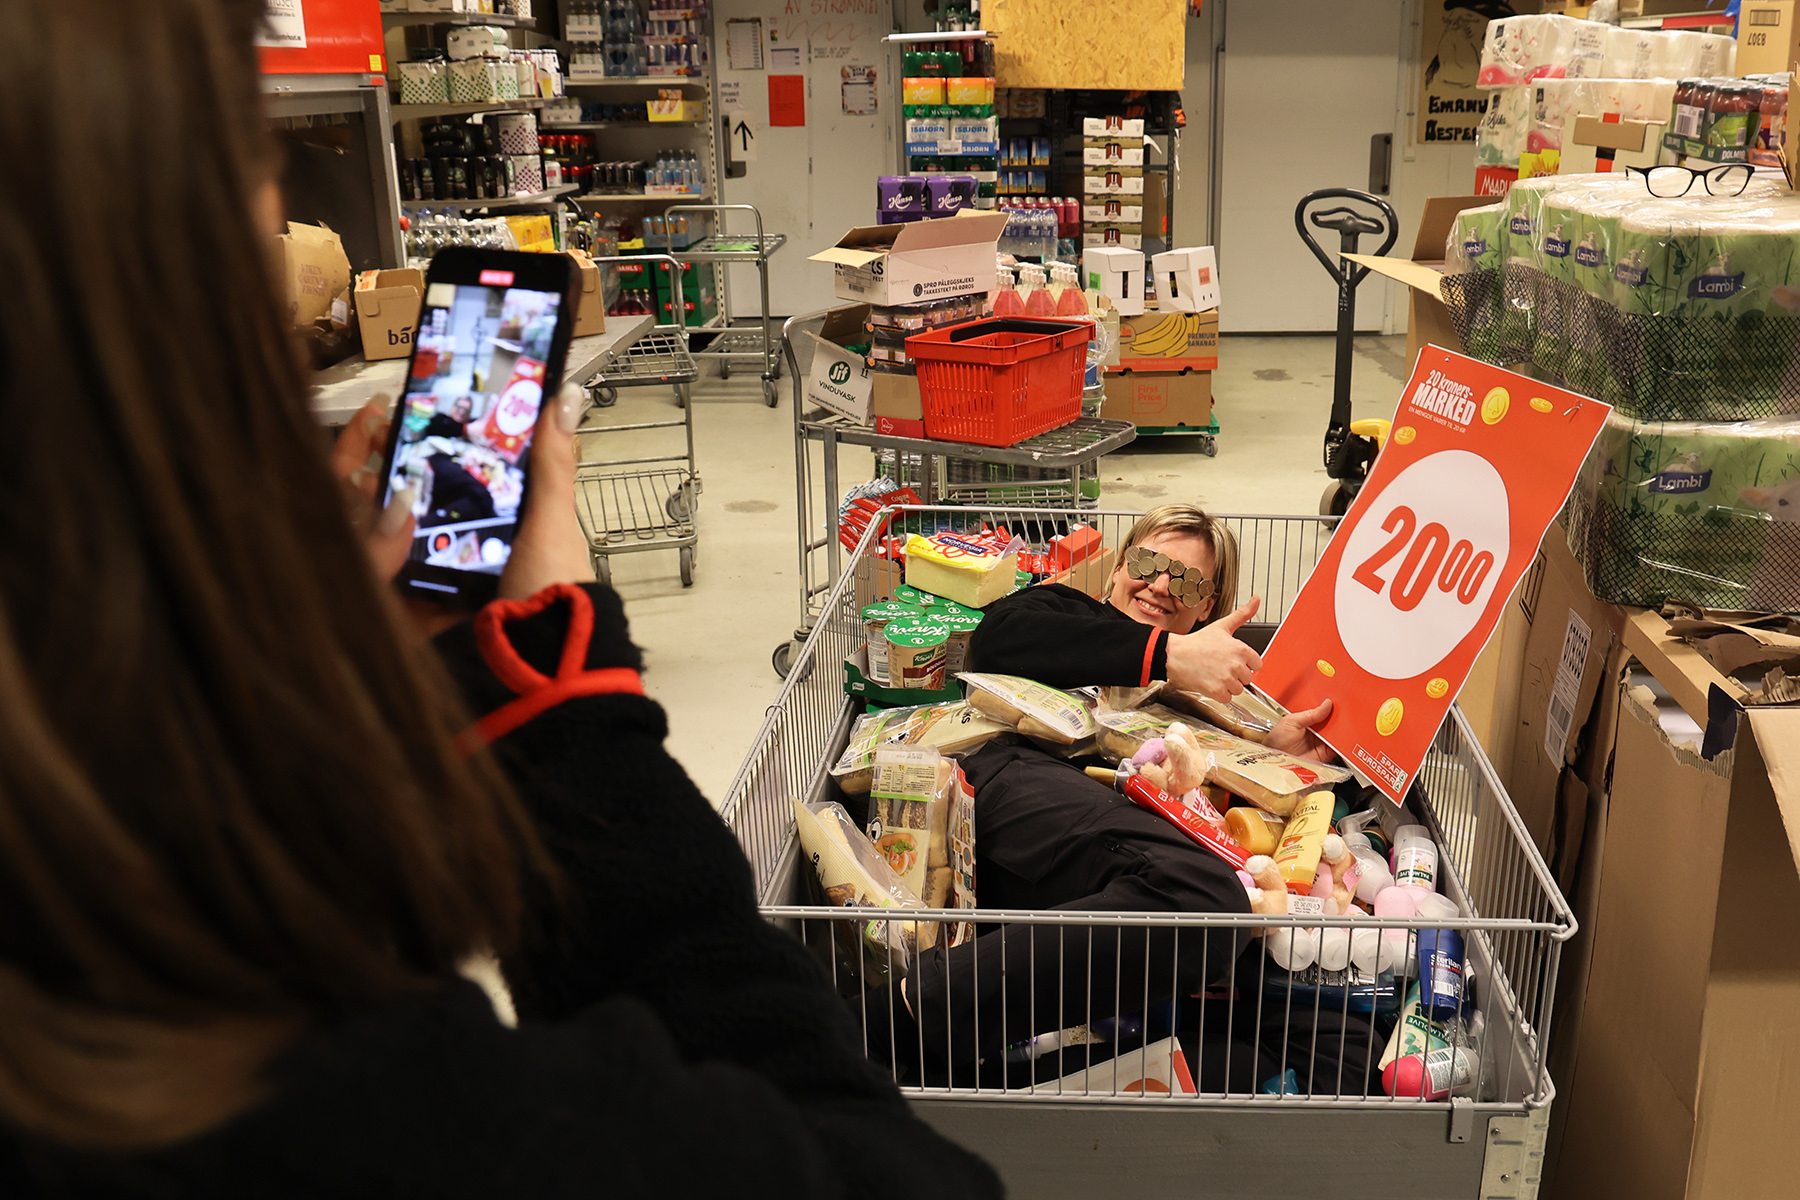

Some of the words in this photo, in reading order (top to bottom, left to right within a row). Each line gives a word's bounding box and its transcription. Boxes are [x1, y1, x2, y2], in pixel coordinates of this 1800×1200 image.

[1721, 150, 1746, 160] DOLMIO
[888, 193, 913, 209] Hansa
[937, 193, 963, 209] Hansa
[1511, 221, 1531, 232] Lamb
[1544, 241, 1566, 253] Lambi
[1576, 249, 1599, 263] Lambi
[1616, 266, 1642, 282] Lambi
[923, 281, 938, 289] SPRØ
[937, 276, 975, 287] PÅLEGGSKJEKS
[1698, 278, 1735, 293] Lambi
[923, 287, 952, 296] TAKKESTEKT
[1188, 332, 1216, 340] PREMIUM
[1187, 339, 1216, 347] BANANAS
[1138, 384, 1158, 393] First
[1425, 369, 1441, 388] 20
[1438, 373, 1474, 399] kroners-
[819, 380, 856, 403] VINDUVASK
[1138, 393, 1162, 401] Price
[1411, 382, 1477, 426] MARKED
[1658, 475, 1703, 489] Lambi
[942, 537, 984, 553] NORVEGIA
[928, 613, 982, 624] Knorr
[889, 624, 948, 637] Knorr
[914, 654, 933, 662] Knorr
[1357, 749, 1396, 787] EUROSPAR
[1380, 756, 1400, 776] SPAR
